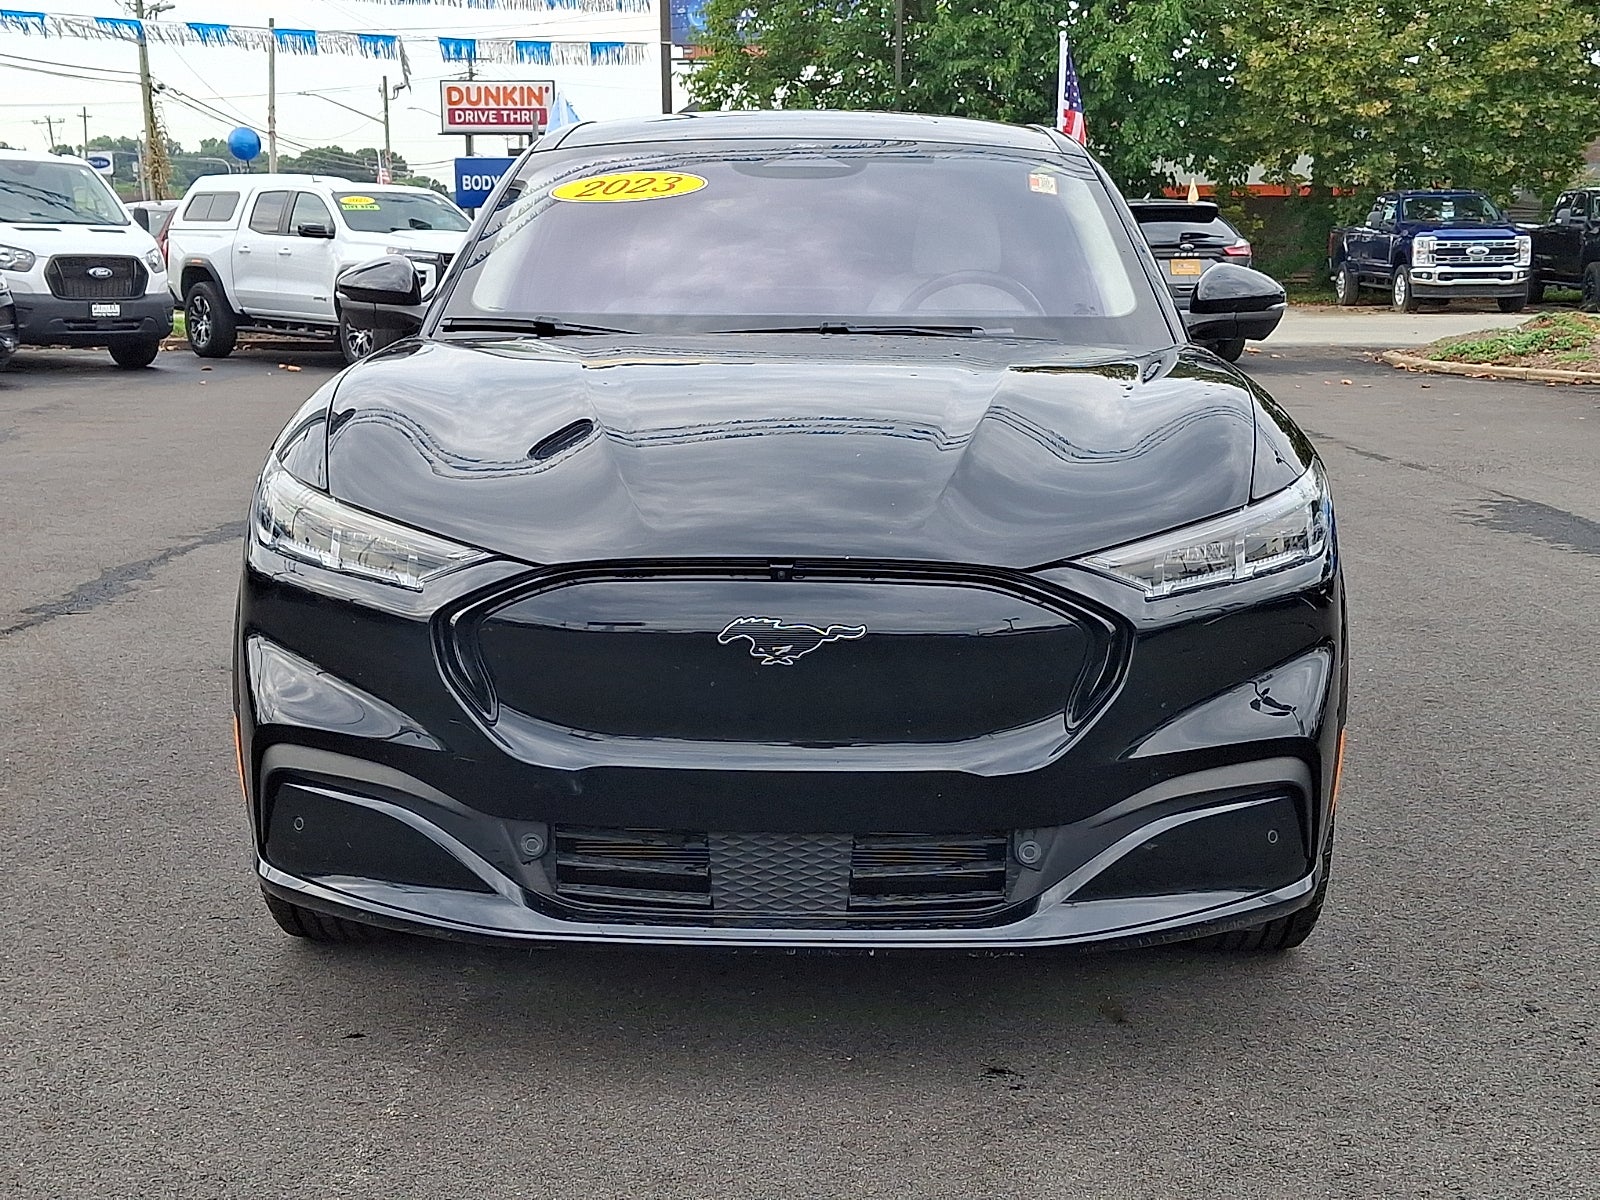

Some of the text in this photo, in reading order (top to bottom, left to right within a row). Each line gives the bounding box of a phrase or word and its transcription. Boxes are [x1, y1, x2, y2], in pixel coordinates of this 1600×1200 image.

[446, 86, 550, 106] DUNKIN'
[454, 110, 498, 123] DRIVE
[574, 176, 683, 197] 2023
